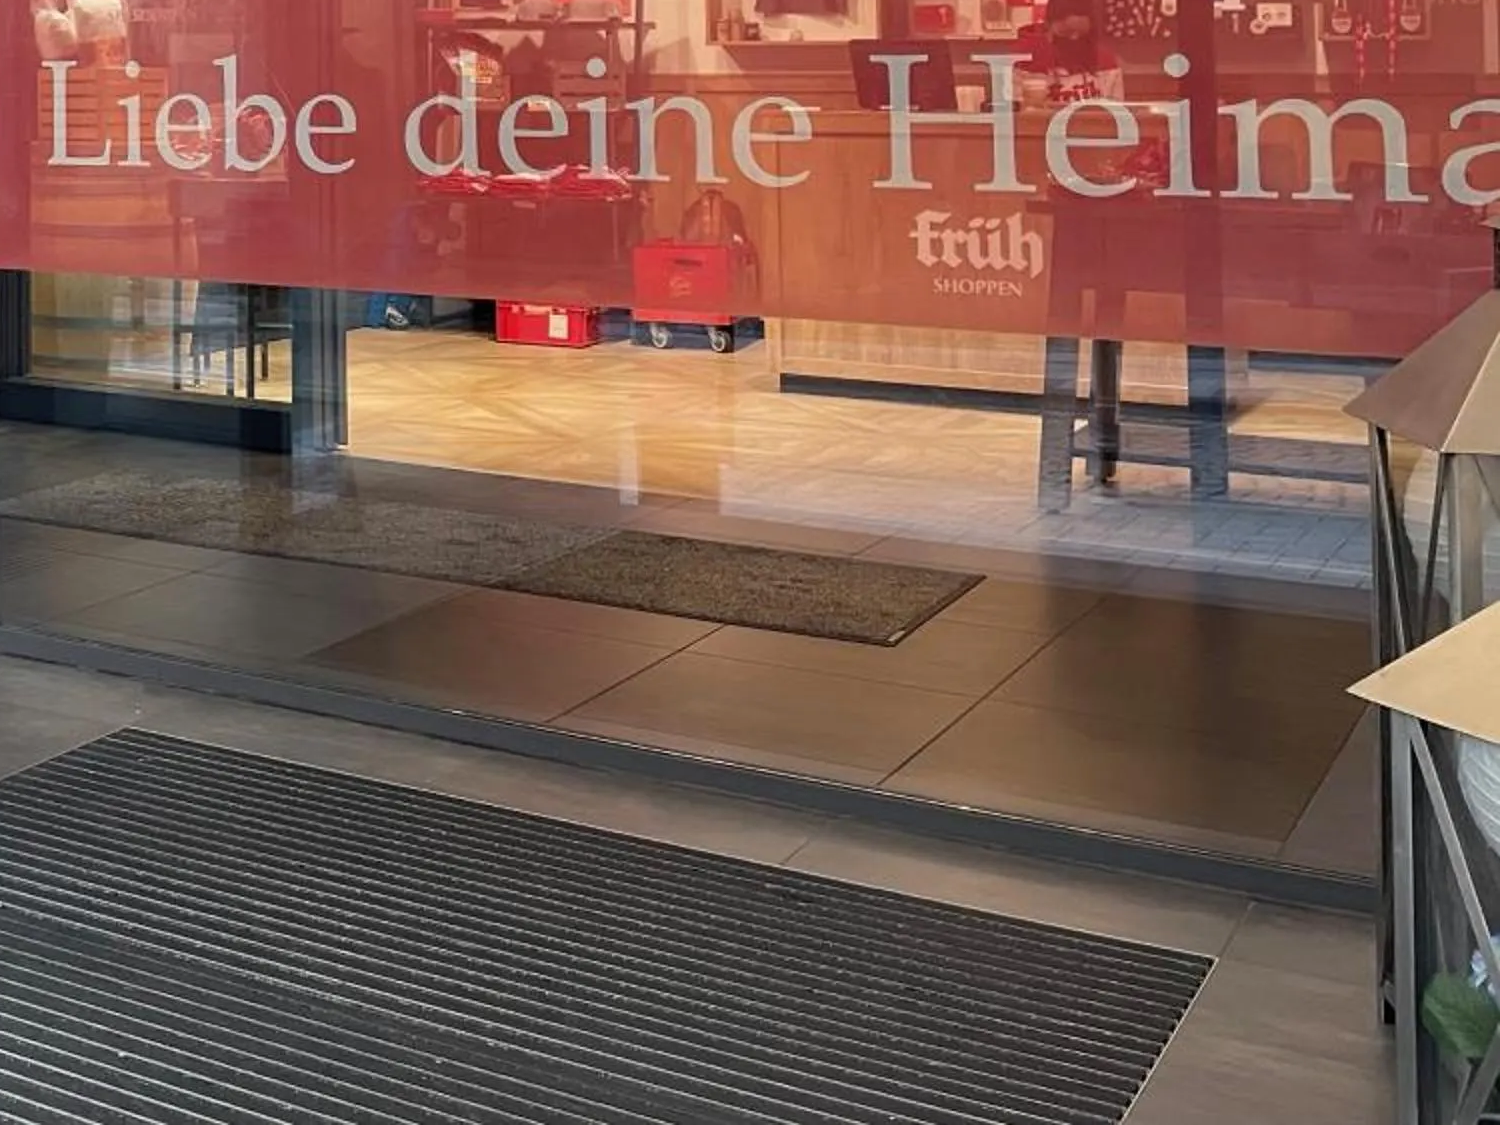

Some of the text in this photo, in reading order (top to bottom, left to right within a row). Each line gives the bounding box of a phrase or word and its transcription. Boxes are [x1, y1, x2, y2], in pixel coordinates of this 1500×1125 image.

[41, 45, 1500, 207] Liebe deine Heima
[908, 209, 1044, 279] früh
[932, 277, 1023, 298] SHOPPEN
